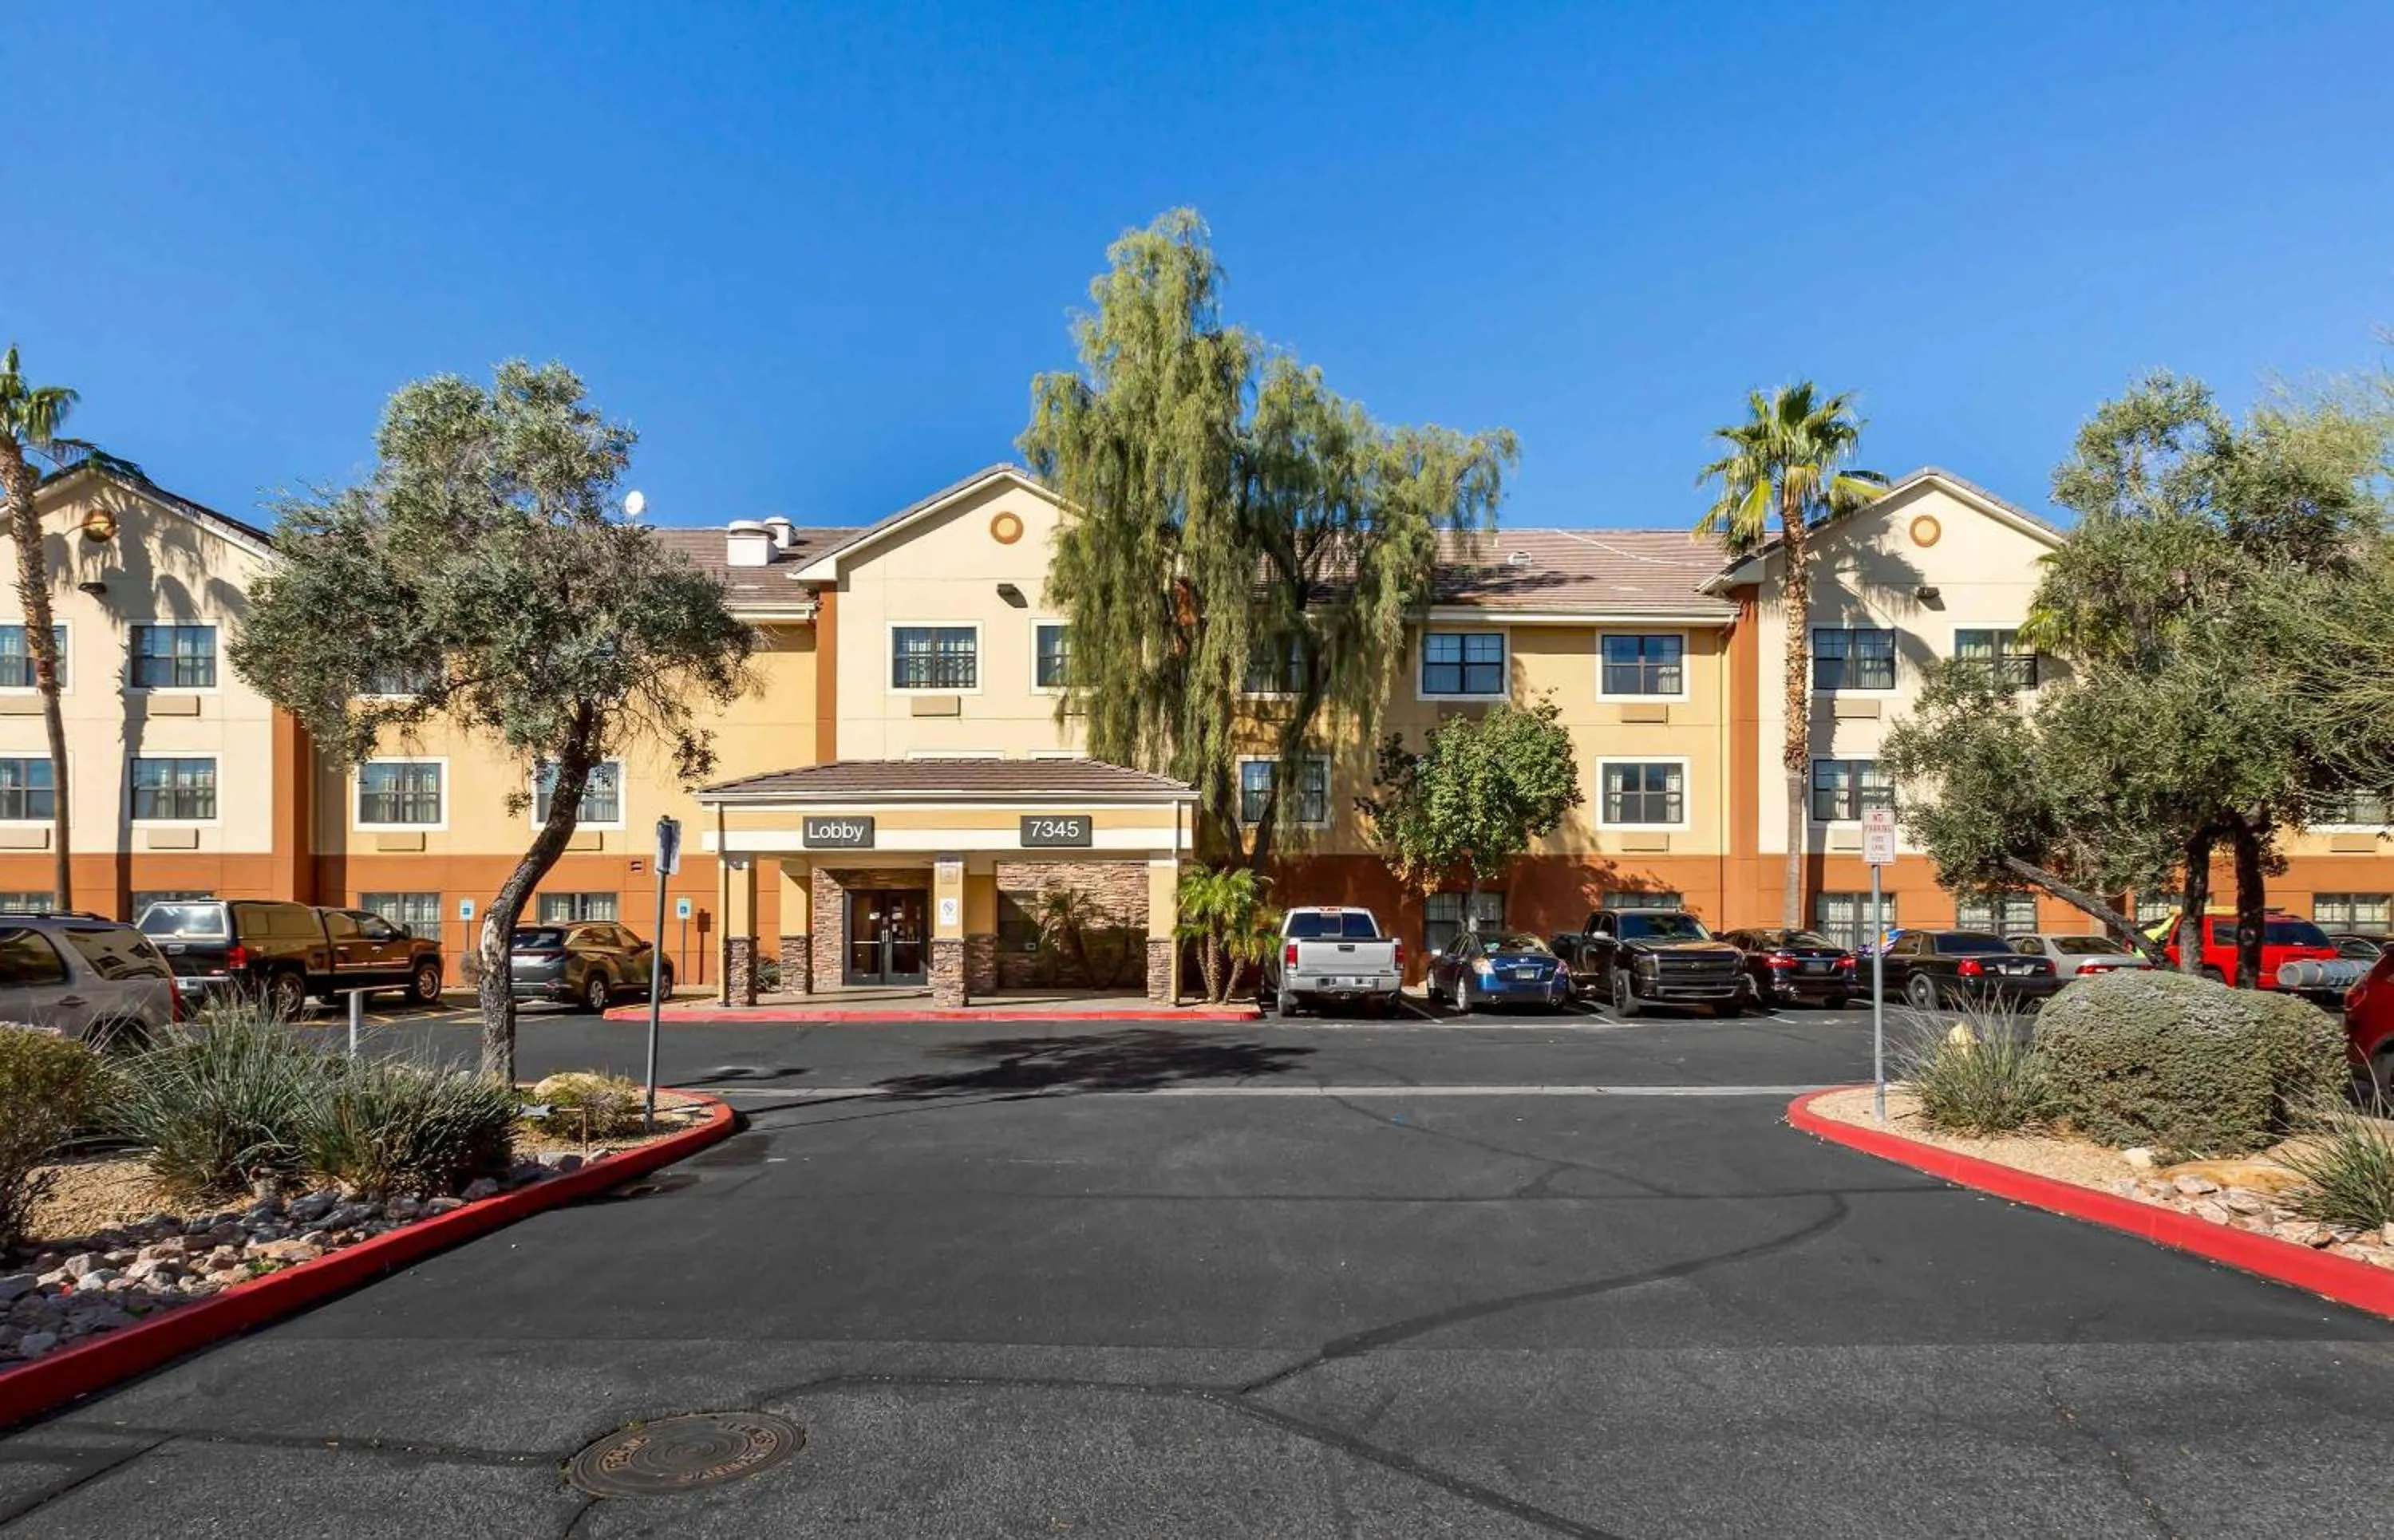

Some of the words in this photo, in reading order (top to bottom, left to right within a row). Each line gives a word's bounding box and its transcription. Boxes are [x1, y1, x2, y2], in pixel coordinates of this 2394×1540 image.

[808, 821, 864, 842] Lobby
[1030, 821, 1079, 838] 7345
[1865, 824, 1892, 833] PARKING
